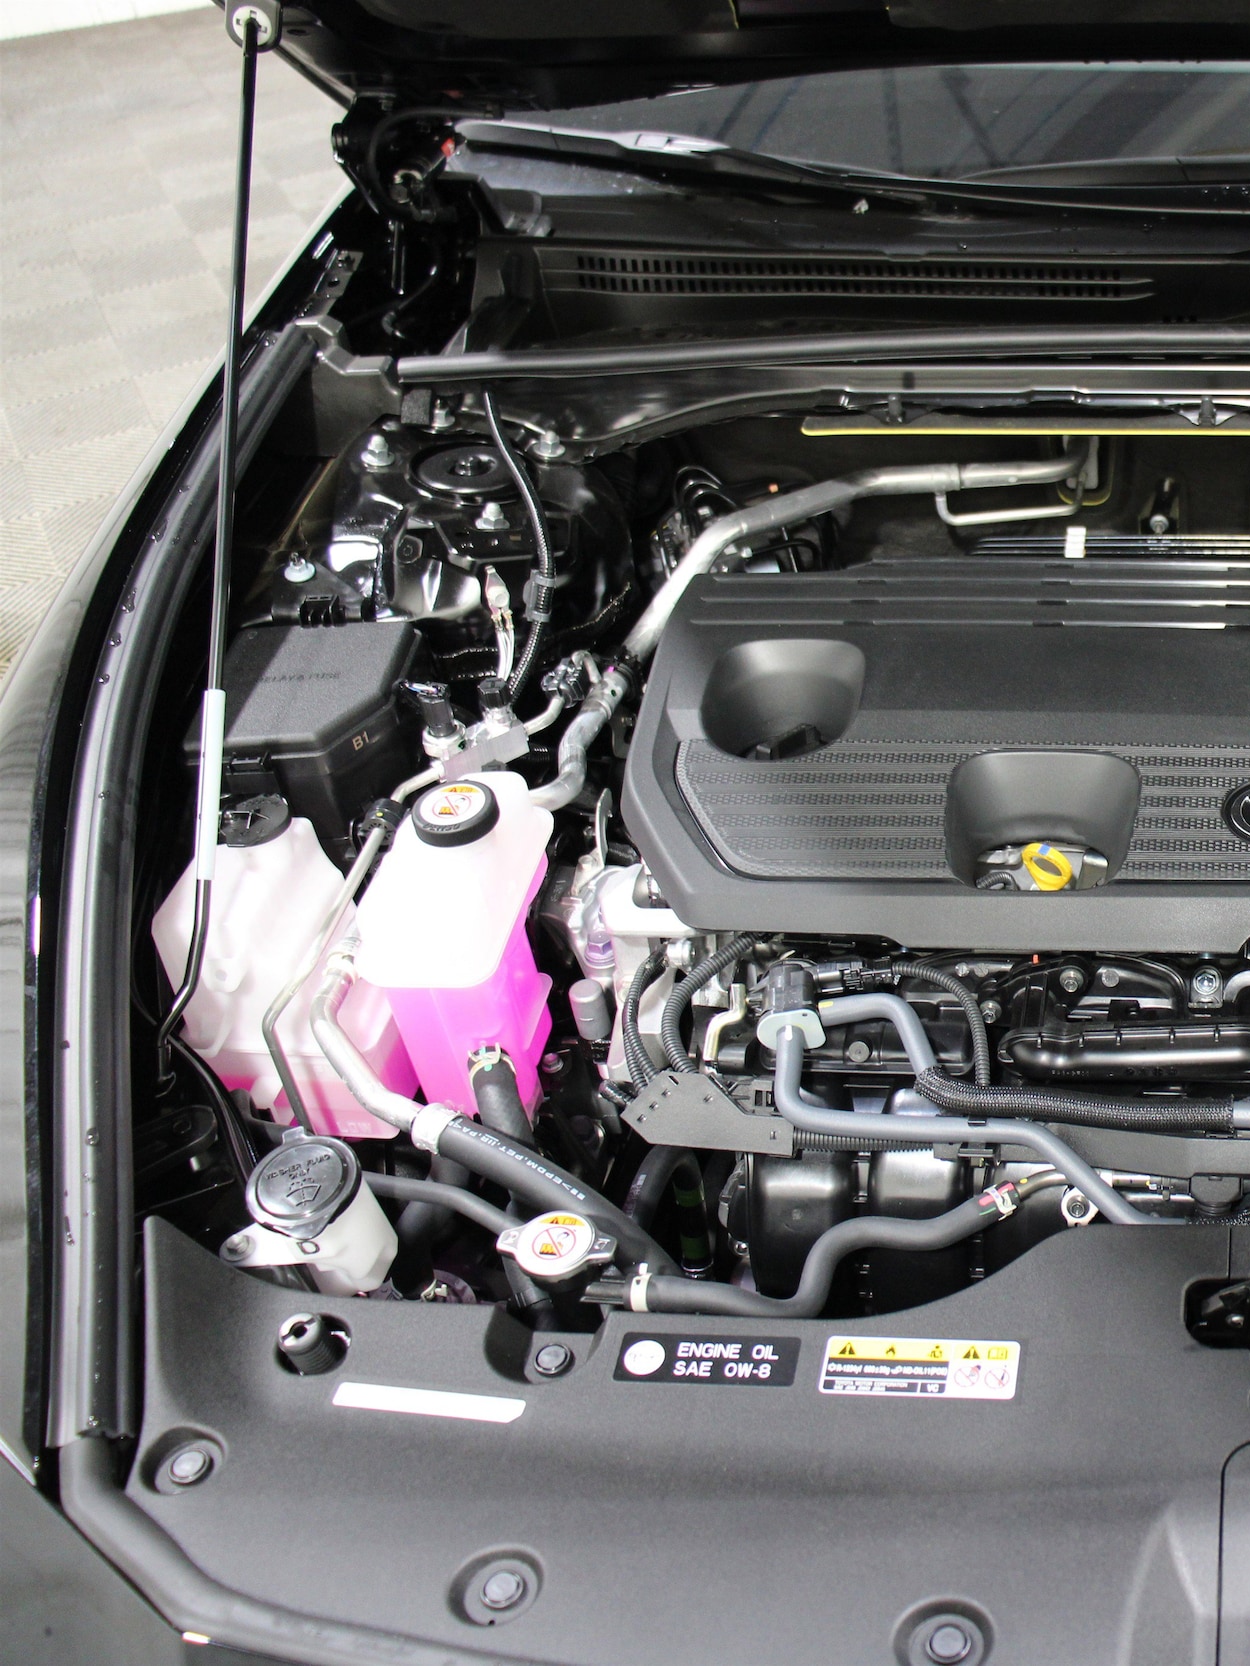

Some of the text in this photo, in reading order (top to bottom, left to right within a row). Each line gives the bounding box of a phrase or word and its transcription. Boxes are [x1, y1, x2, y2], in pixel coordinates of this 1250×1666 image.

[351, 730, 370, 751] B1
[677, 1342, 780, 1361] ENGINE OIL
[673, 1361, 714, 1377] SAE
